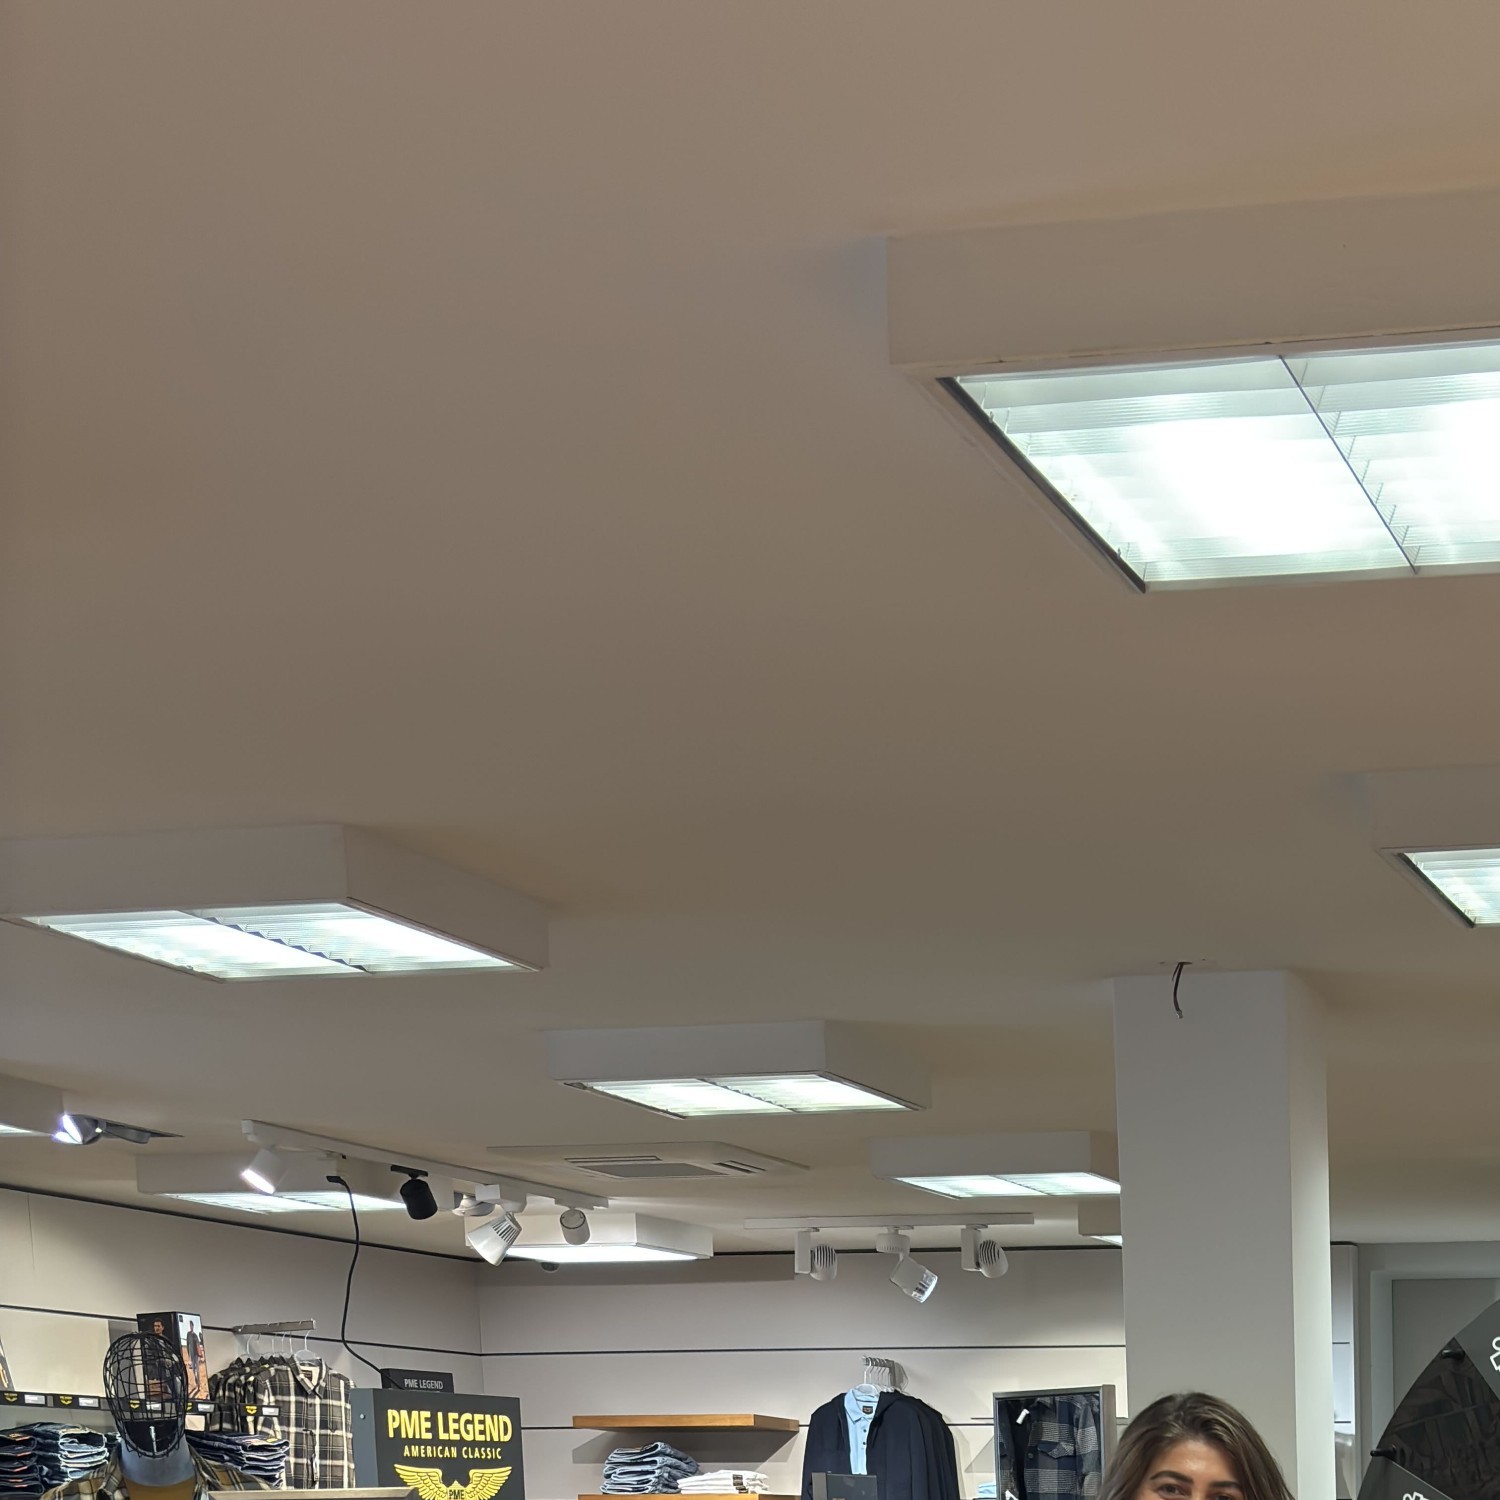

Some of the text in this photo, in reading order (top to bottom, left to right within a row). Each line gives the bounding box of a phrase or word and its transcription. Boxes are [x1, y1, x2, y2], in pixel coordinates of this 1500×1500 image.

[404, 1378, 444, 1390] PME LEGEND
[387, 1409, 513, 1442] PME LEGEND
[403, 1445, 502, 1459] AMERICAN CLASSIC
[449, 1489, 464, 1500] PME
